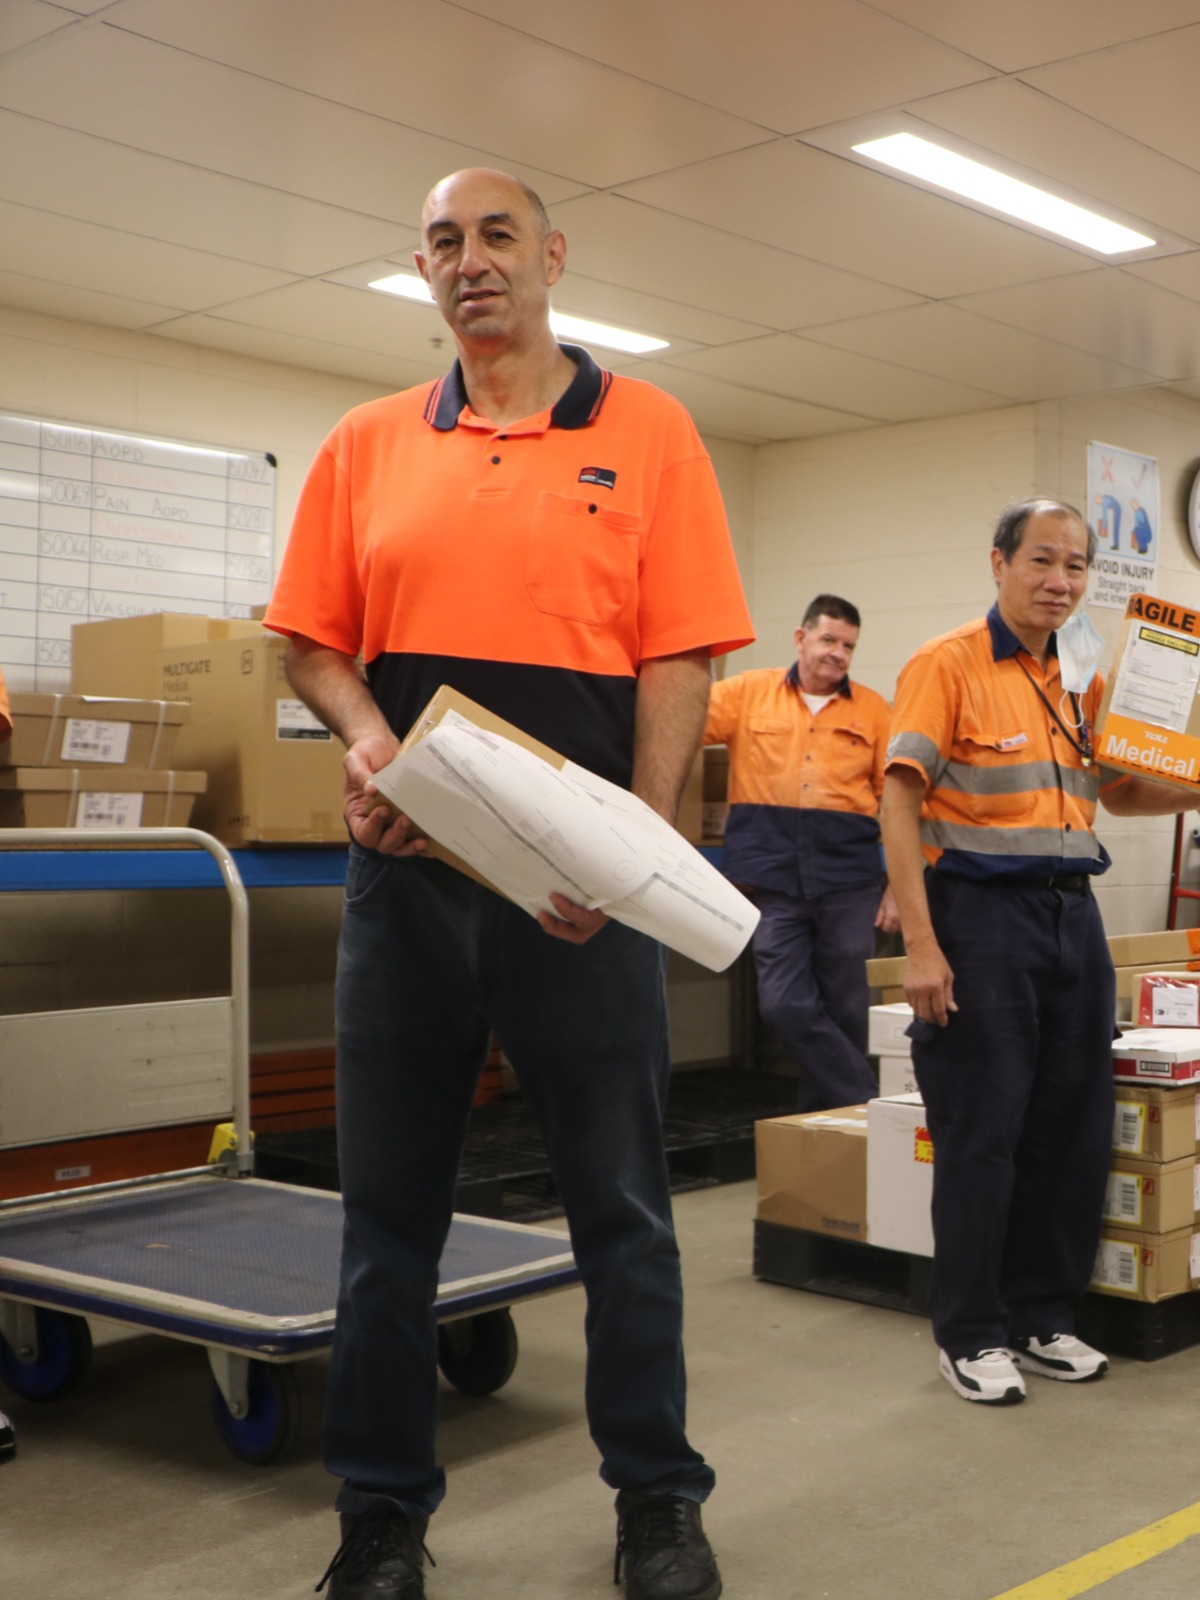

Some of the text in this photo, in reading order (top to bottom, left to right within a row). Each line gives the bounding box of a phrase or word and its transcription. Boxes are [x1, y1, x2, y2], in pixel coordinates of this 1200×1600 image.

[93, 485, 130, 511] PAIN
[93, 539, 129, 562] RESP
[136, 546, 164, 567] MED
[1090, 558, 1154, 580] AVOID INJURY
[1098, 576, 1127, 593] Straight
[91, 591, 166, 616] VASCU
[1094, 591, 1128, 605] and knee
[1132, 597, 1196, 633] AGILE
[163, 660, 211, 676] MULTIGATE
[1144, 730, 1169, 744] TOLL
[1106, 734, 1196, 777] Medical
